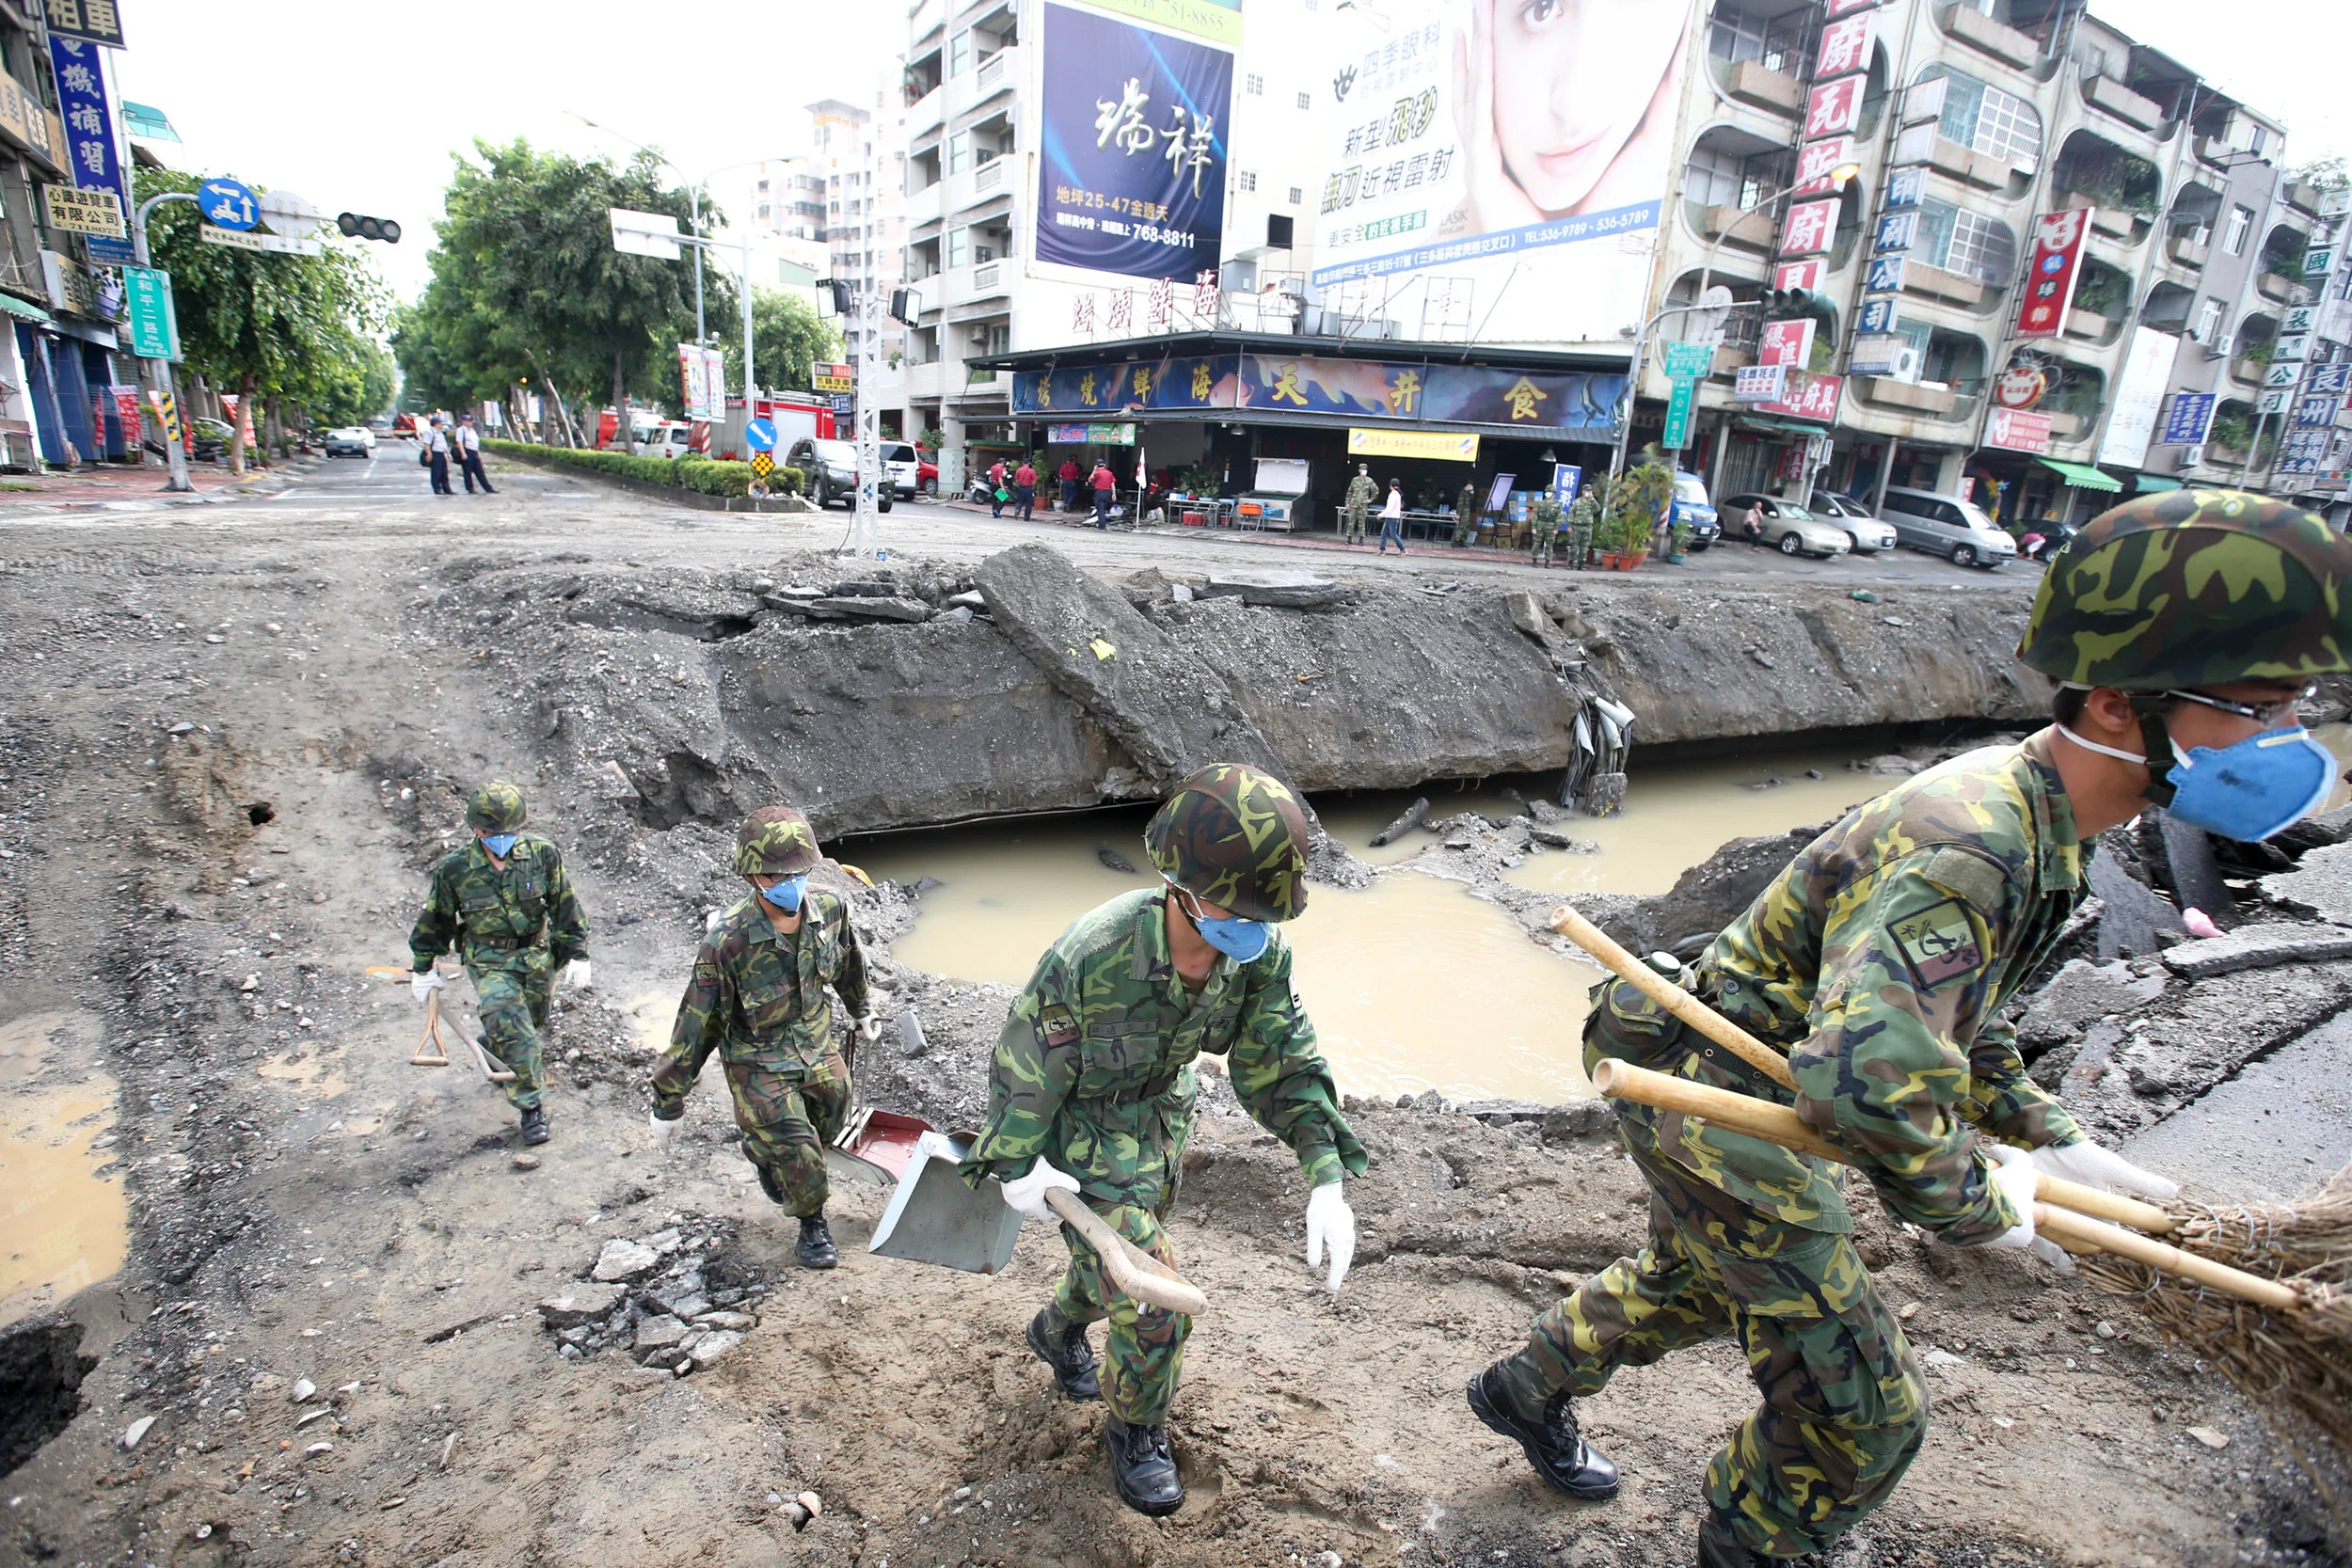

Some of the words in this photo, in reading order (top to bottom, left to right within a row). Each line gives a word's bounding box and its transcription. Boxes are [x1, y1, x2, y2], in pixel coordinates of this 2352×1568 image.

[1363, 19, 1440, 78] 四季眼科
[1094, 77, 1214, 199] 瑞祥
[1343, 86, 1438, 159] 新型飛秒
[1321, 144, 1454, 214] 無刀近視雷射
[51, 205, 119, 226] 有限公司
[1133, 223, 1195, 248] 768-8811
[136, 279, 159, 334] 和平二路
[1560, 471, 1576, 516] 指揮
